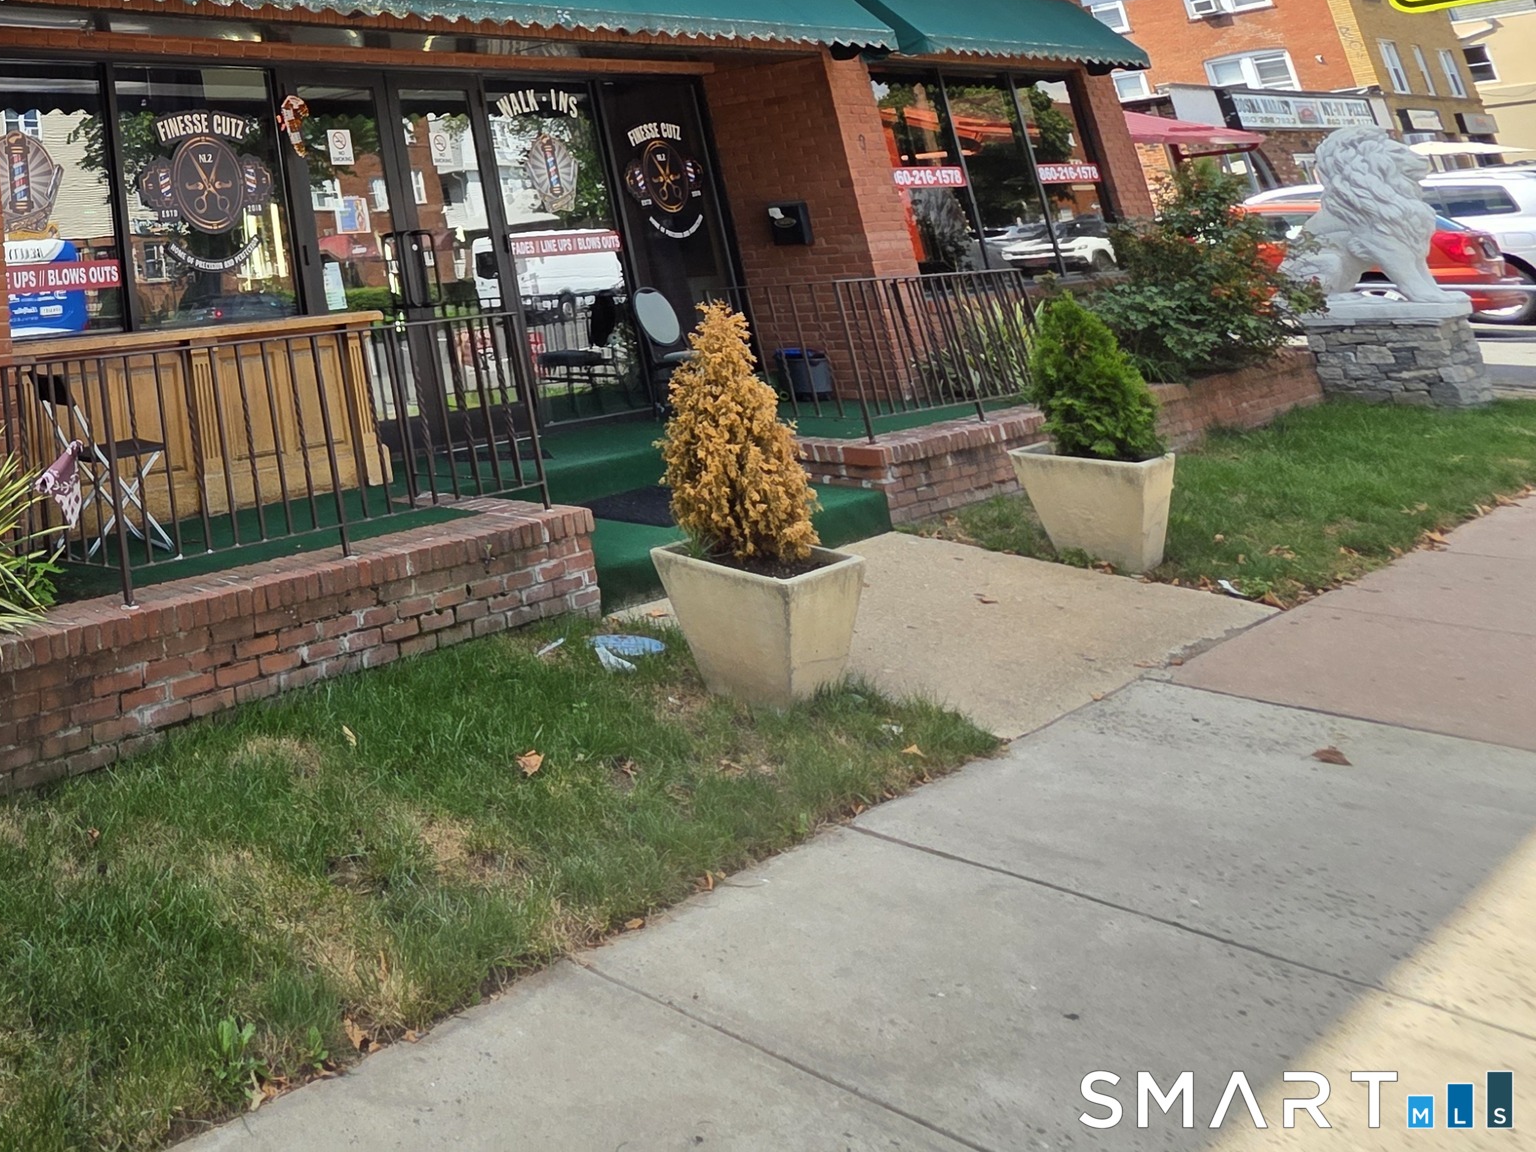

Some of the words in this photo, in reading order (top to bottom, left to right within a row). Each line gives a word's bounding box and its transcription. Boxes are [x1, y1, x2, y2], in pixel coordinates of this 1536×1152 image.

[156, 113, 210, 142] FINESSE
[213, 114, 245, 140] CUTZ
[627, 122, 660, 147] FINESSE
[660, 122, 681, 141] CUTZ
[1038, 166, 1099, 181] 860-216-1578
[511, 241, 534, 255] FADES
[541, 240, 558, 253] LINE
[558, 238, 572, 251] UPS
[577, 237, 601, 250] BLOWS
[602, 235, 620, 248] OUTS
[13, 271, 36, 288] UPS
[47, 268, 87, 286] BLOWS
[88, 266, 119, 284] OUTS
